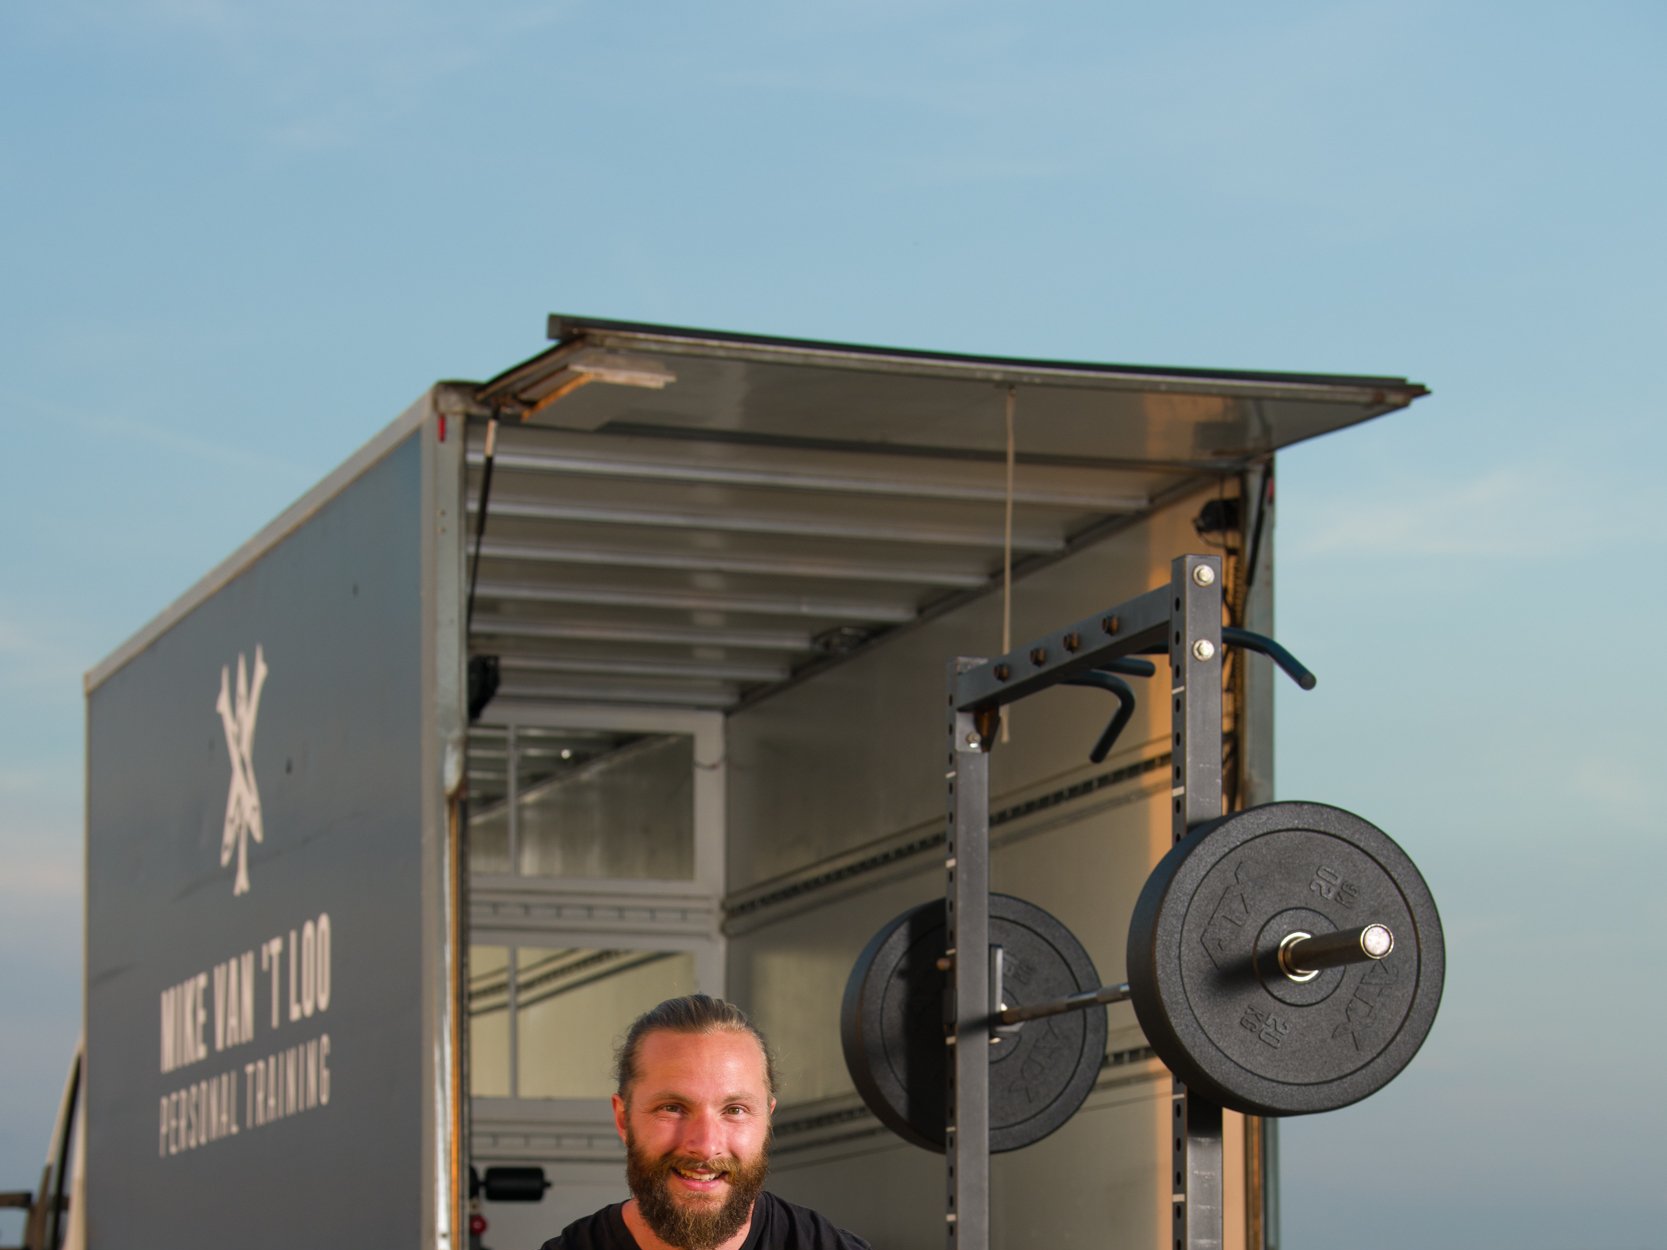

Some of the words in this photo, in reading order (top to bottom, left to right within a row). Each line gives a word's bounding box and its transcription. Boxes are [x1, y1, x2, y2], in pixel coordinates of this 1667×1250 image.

[1309, 865, 1343, 901] 20
[1335, 881, 1358, 909] KG
[160, 970, 207, 1074] MIKE
[213, 949, 255, 1052] VAN
[289, 912, 331, 1023] LOO
[1239, 1004, 1264, 1033] KG
[1258, 1012, 1290, 1049] 20
[159, 1070, 240, 1158] PERSONAL
[245, 1033, 331, 1129] TRAINING
